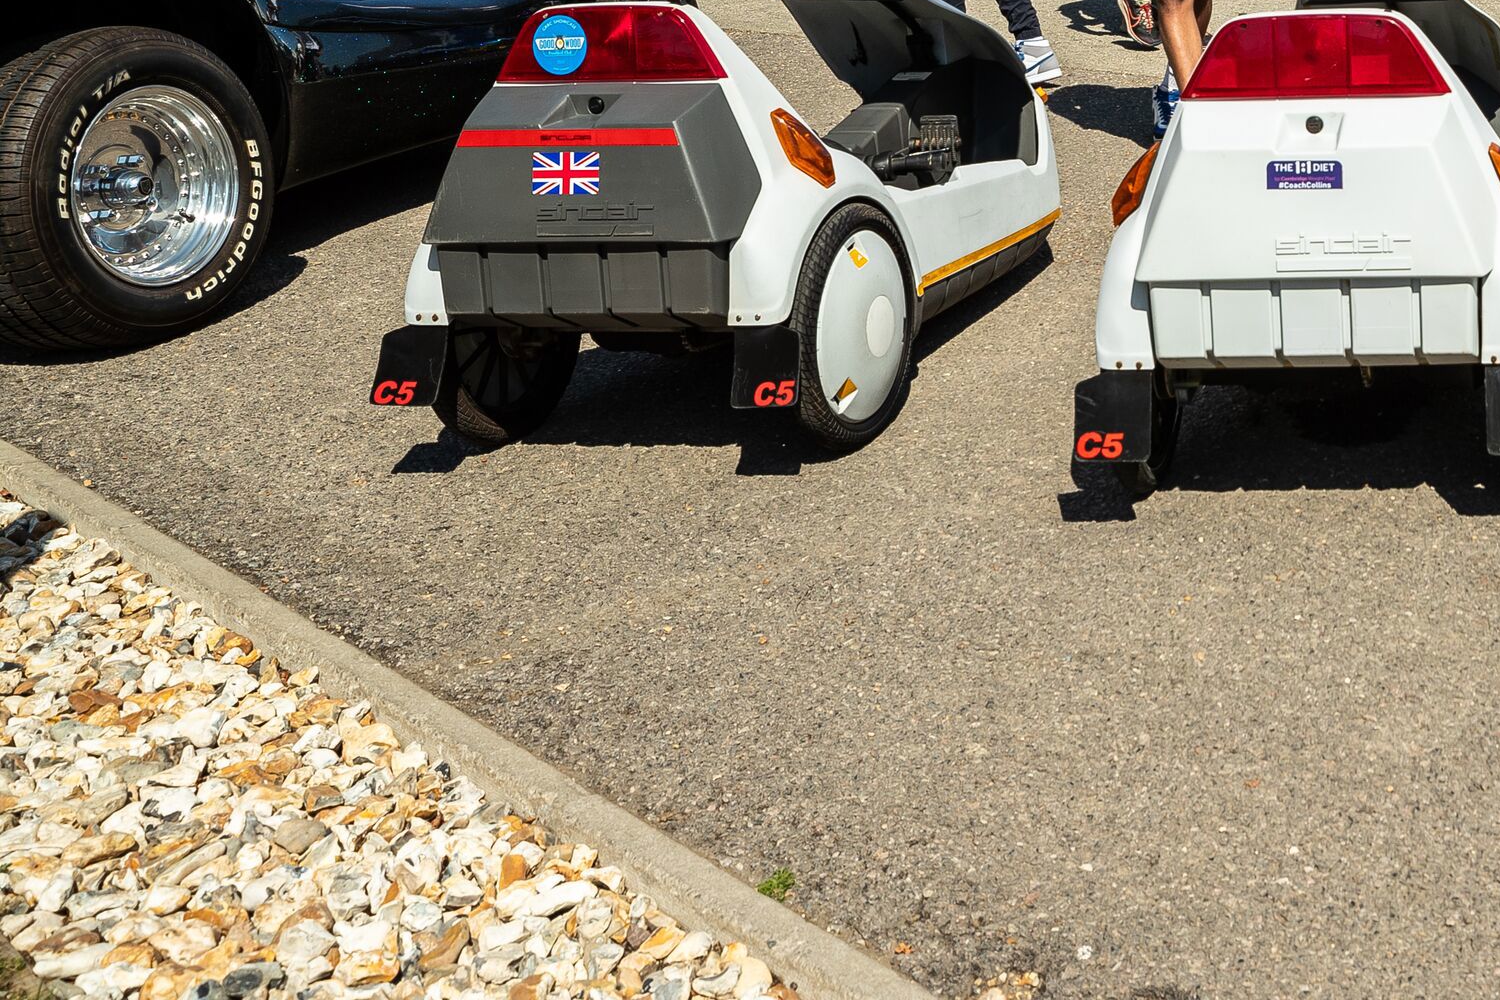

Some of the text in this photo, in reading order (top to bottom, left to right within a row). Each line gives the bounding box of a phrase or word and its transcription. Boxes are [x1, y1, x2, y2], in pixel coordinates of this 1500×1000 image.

[57, 105, 88, 219] Radial
[1274, 163, 1293, 172] THE
[1313, 163, 1335, 172] DIET
[184, 139, 263, 302] BFGoodrich
[537, 202, 654, 221] sinclair
[1276, 232, 1411, 256] sinclair
[374, 380, 417, 405] C5
[754, 380, 795, 407] C5
[1077, 431, 1124, 459] C5
